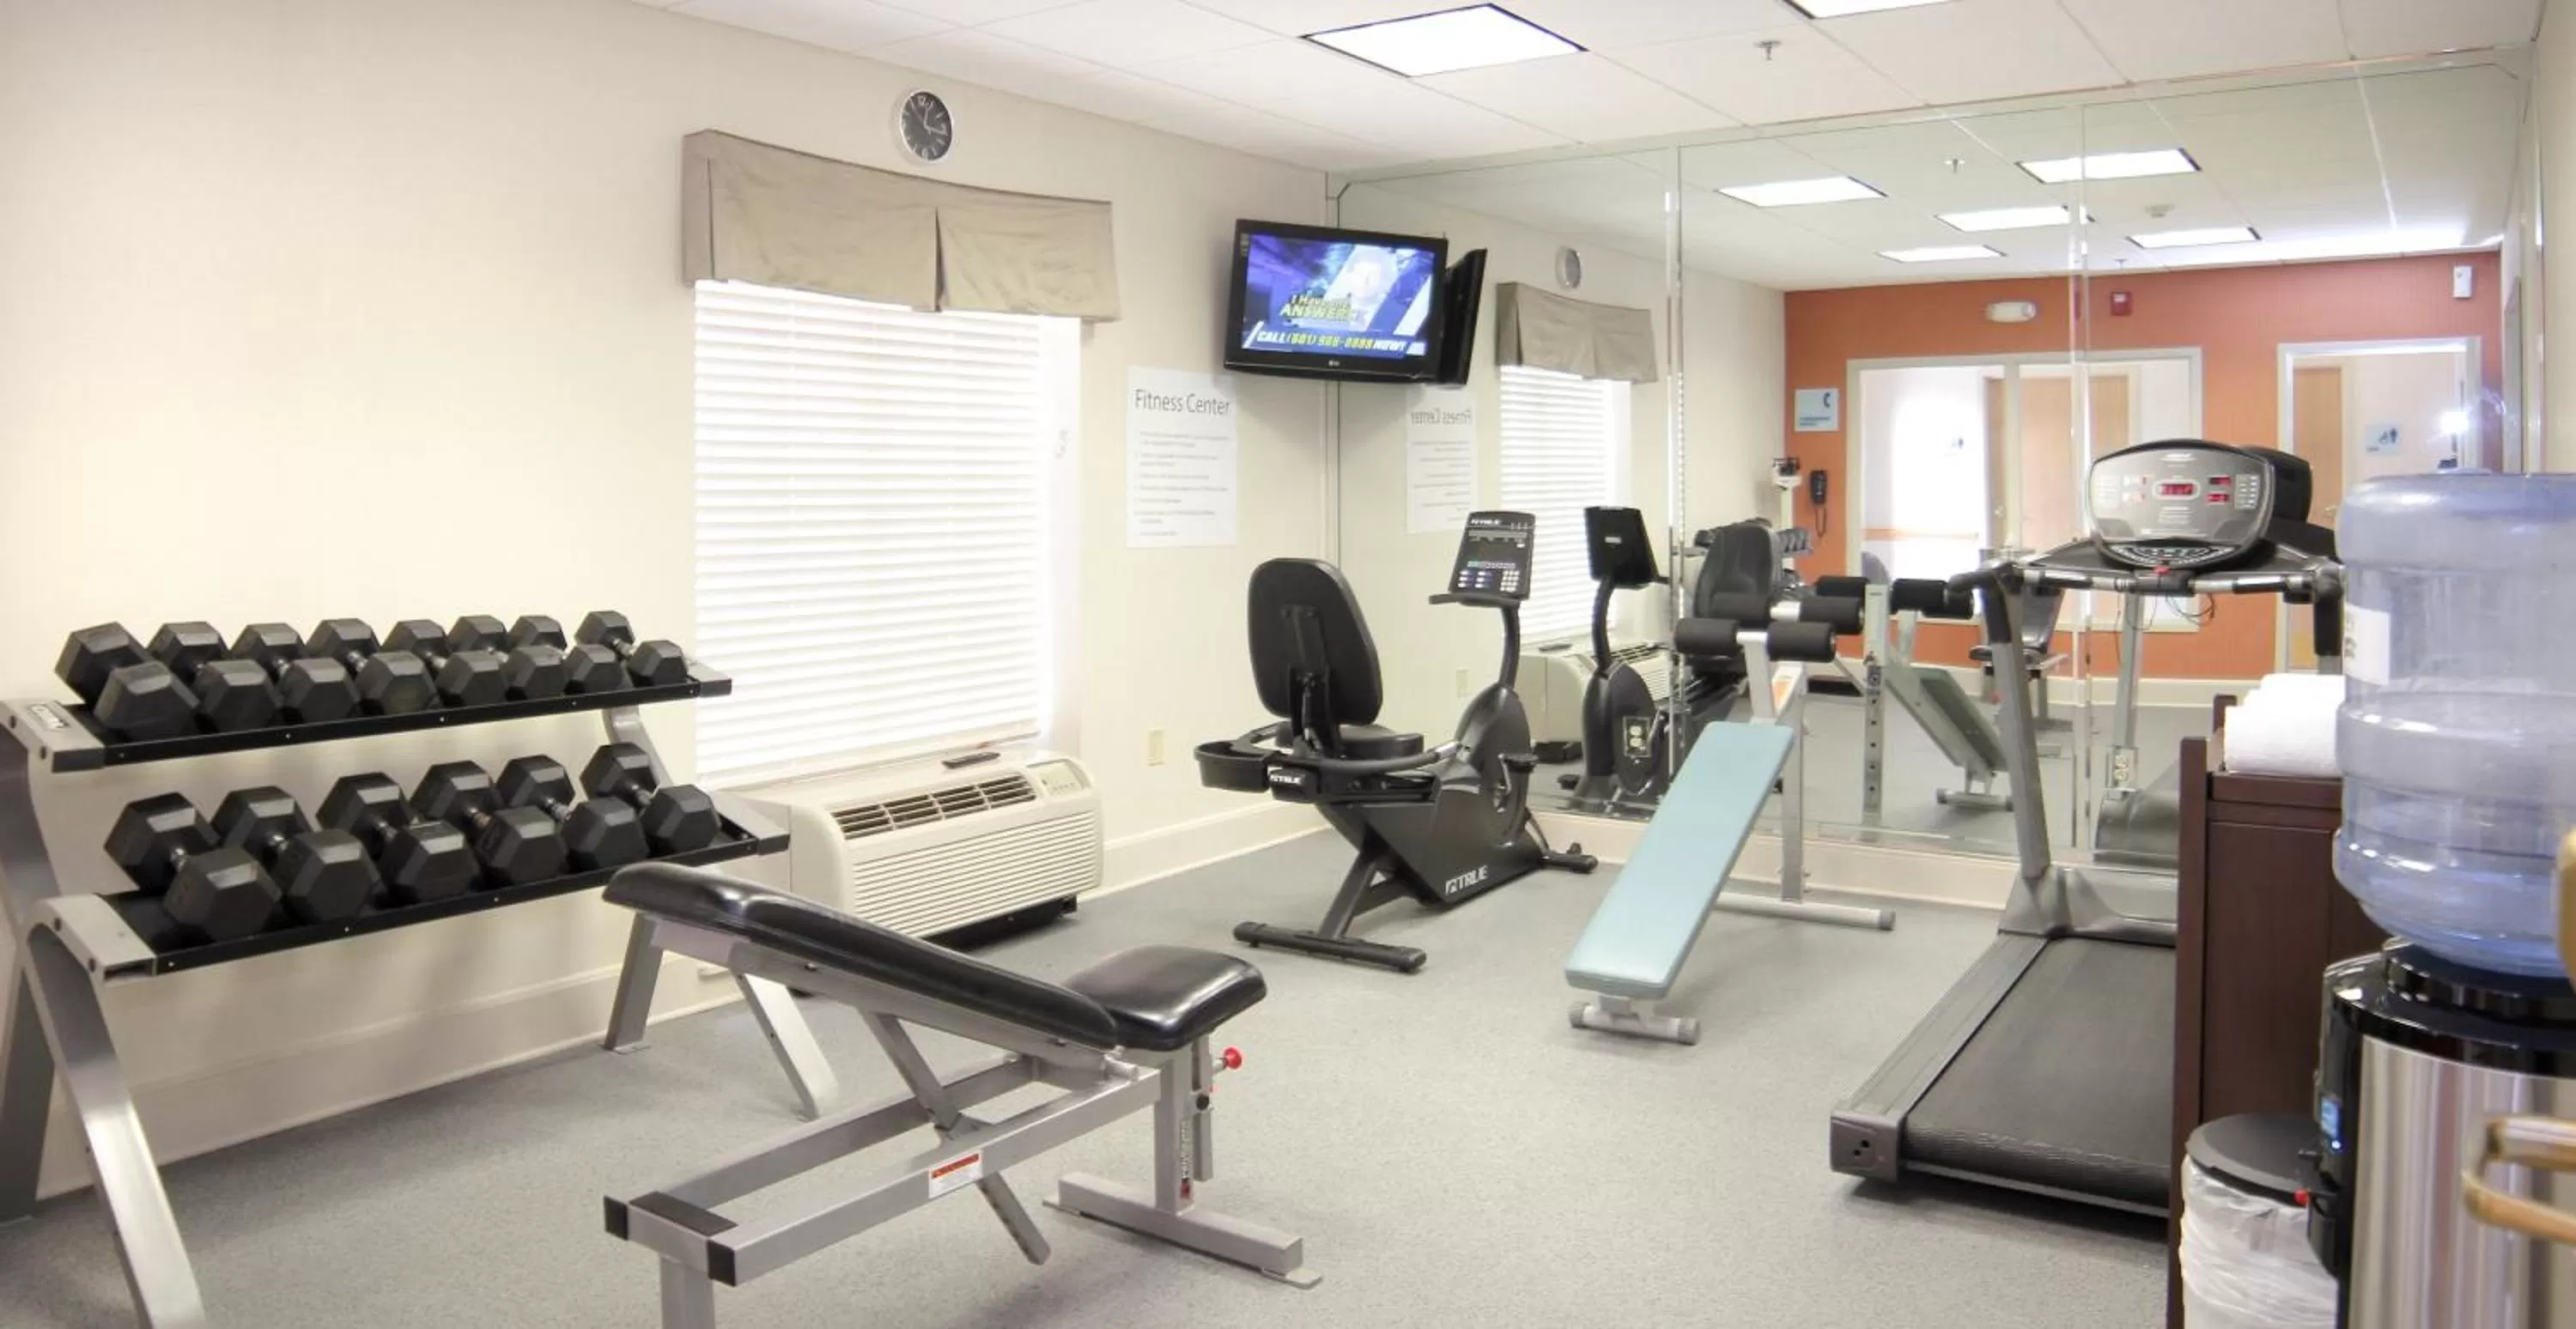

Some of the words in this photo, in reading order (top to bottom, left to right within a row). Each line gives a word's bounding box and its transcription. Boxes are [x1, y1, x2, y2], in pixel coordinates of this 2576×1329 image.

[1257, 331, 1286, 344] CALL
[1135, 389, 1183, 412] Fitness
[1186, 392, 1230, 415] Center
[1456, 865, 1487, 890] TRUE
